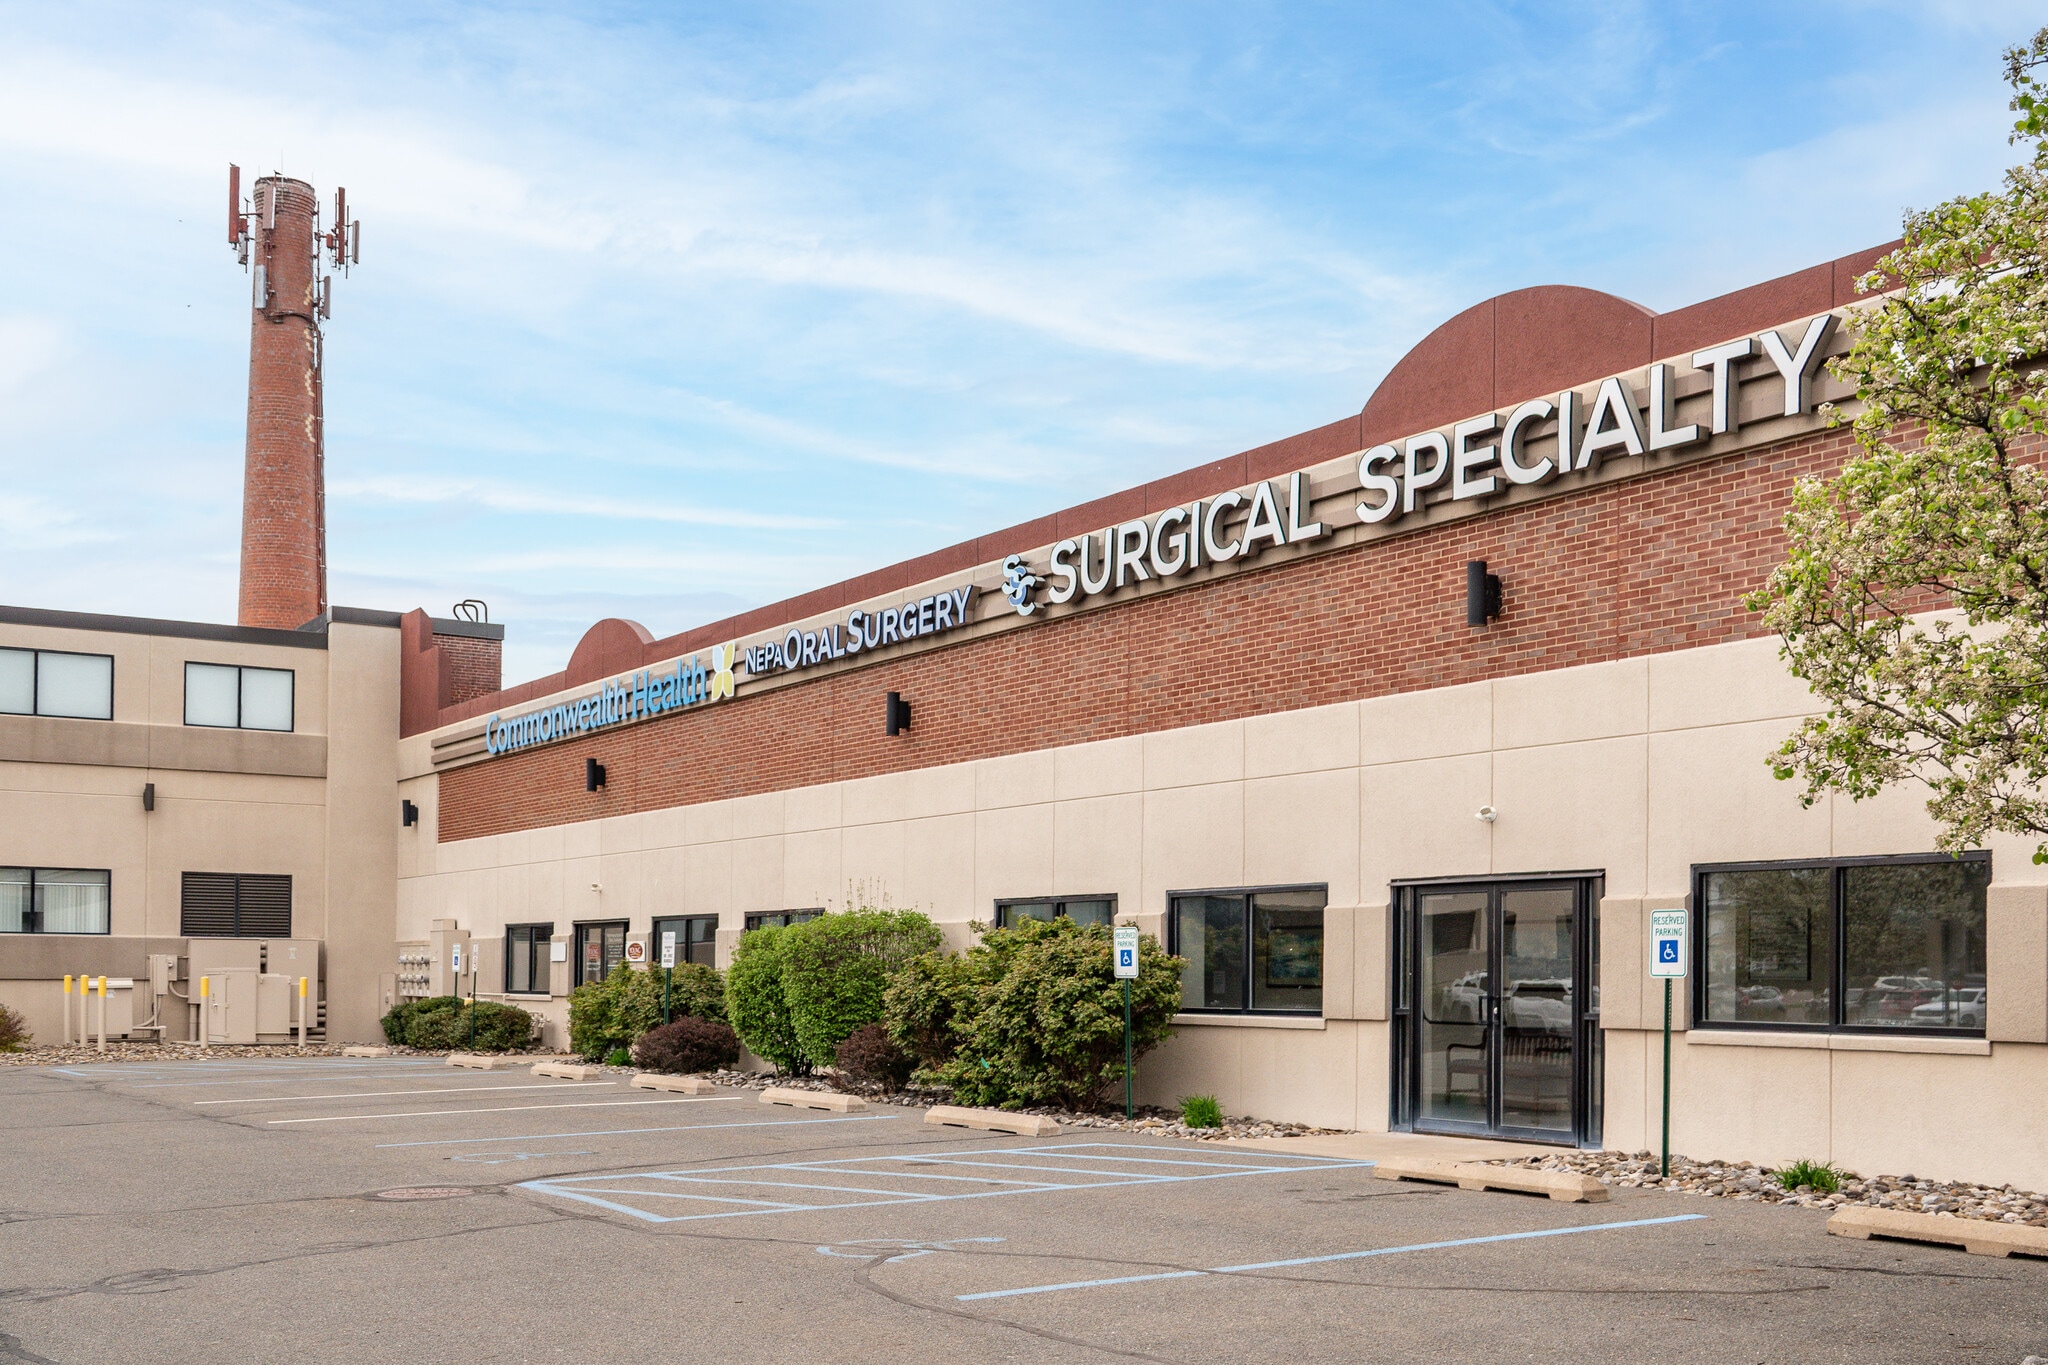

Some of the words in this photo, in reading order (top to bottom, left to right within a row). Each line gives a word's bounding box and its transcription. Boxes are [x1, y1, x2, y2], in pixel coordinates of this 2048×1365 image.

[1049, 471, 1324, 605] SURGICAL
[1355, 314, 1834, 524] SPECIALTY
[846, 584, 974, 654] SURGERY
[486, 677, 627, 755] Commonwealth
[631, 655, 707, 718] Health
[1653, 916, 1685, 925] RESERVED
[1655, 928, 1683, 936] PARKING
